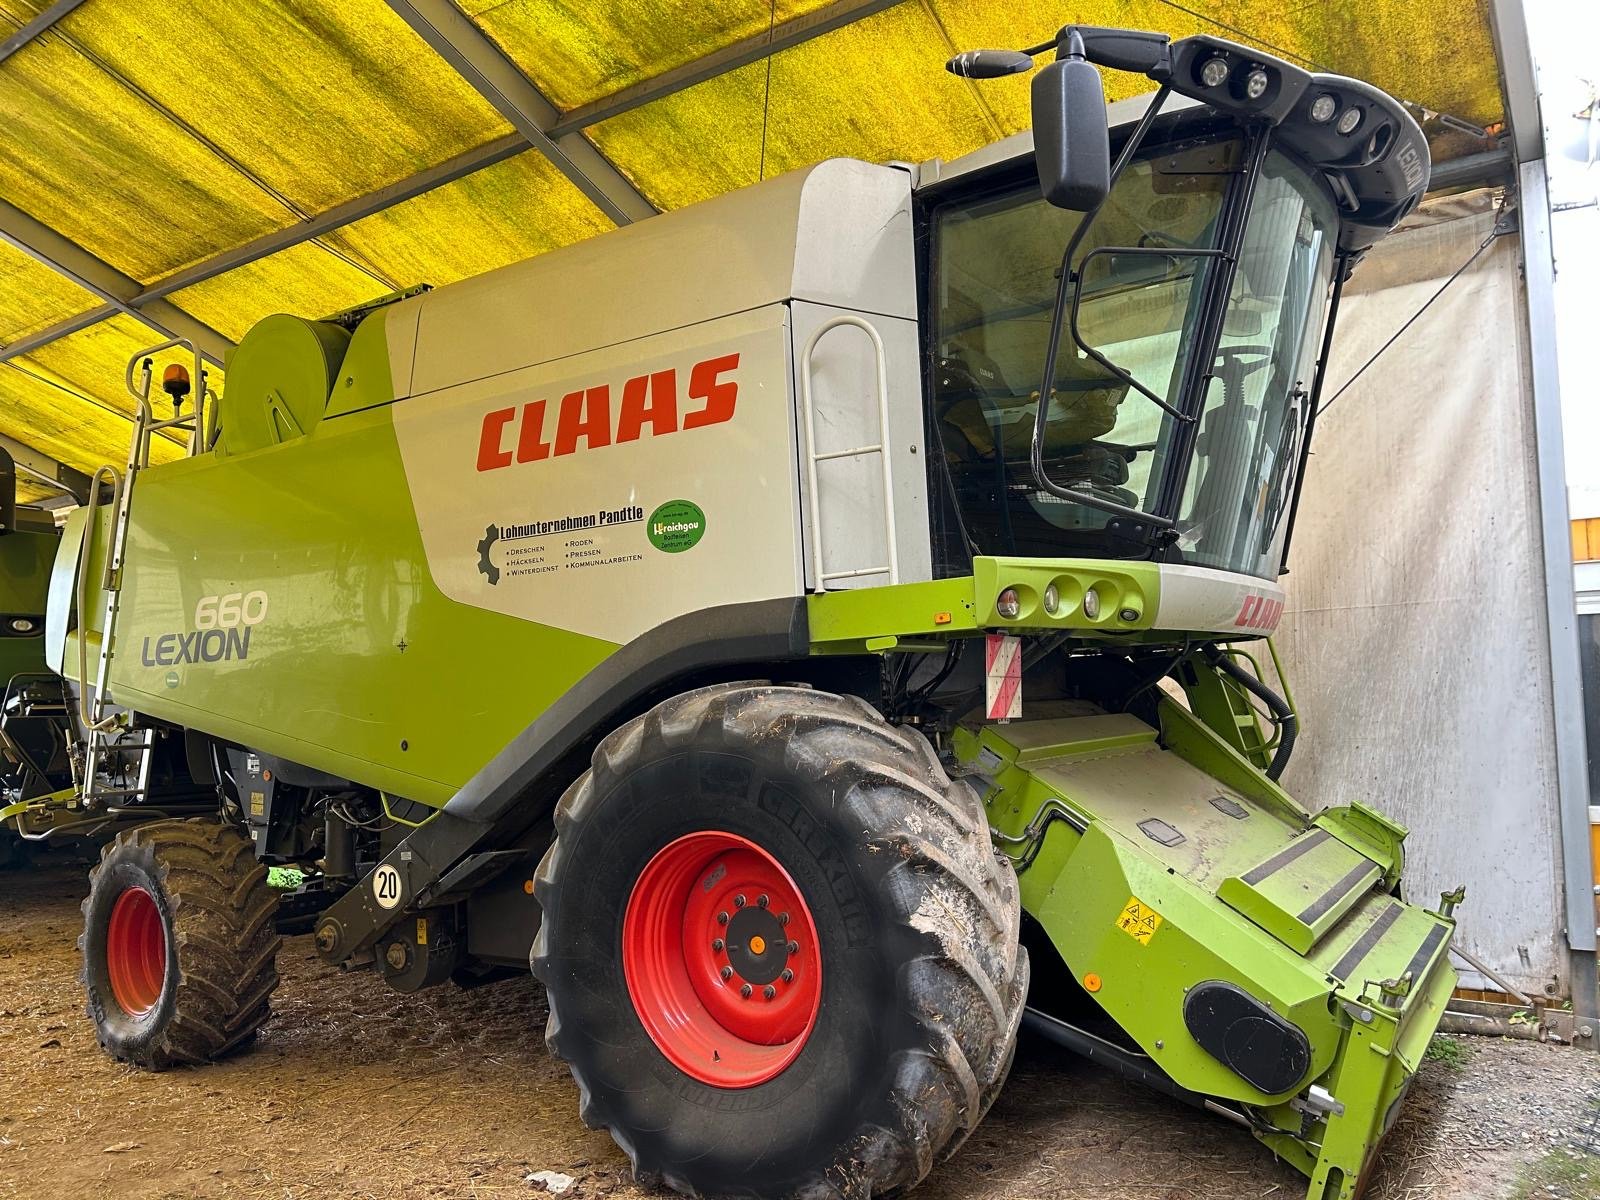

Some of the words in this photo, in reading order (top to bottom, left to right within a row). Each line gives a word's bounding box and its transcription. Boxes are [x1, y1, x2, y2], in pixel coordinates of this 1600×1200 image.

[1395, 141, 1425, 191] LEXION
[476, 352, 740, 473] CLAAS
[500, 514, 596, 540] Lohnunternehmen
[599, 506, 643, 525] Pandtle
[510, 546, 545, 556] DRESCHEN
[569, 539, 593, 547] RODEN
[570, 549, 601, 559] PRESSEN
[511, 565, 559, 576] WINTERDIENST
[570, 554, 643, 569] KOMMUNALARBEITEN
[194, 590, 268, 630] 660
[1234, 595, 1282, 630] CLAA
[141, 626, 252, 667] LEXION
[378, 871, 397, 899] 20
